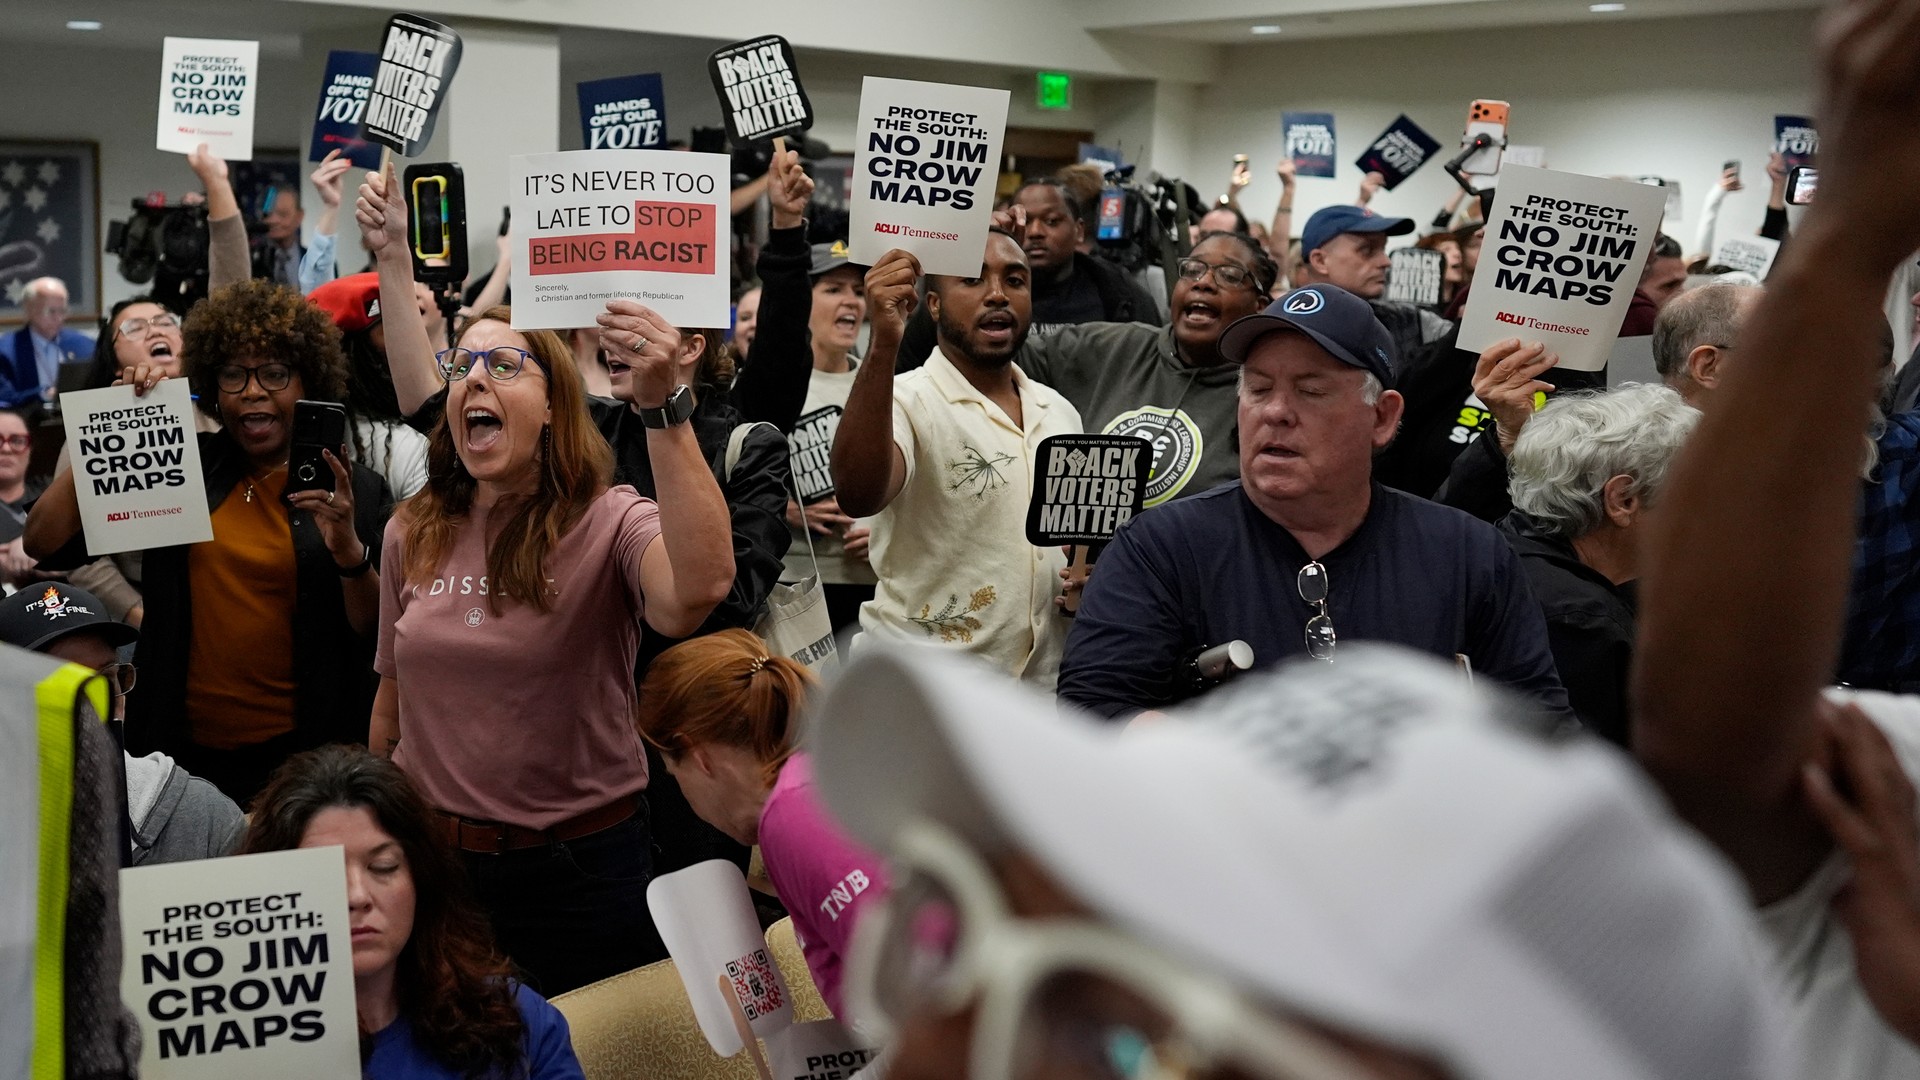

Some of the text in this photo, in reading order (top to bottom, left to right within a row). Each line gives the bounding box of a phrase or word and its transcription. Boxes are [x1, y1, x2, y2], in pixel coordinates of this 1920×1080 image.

[174, 62, 246, 72] THE SOUTH:
[182, 55, 239, 64] PROTECT
[171, 72, 246, 86] NO JIM
[327, 85, 352, 97] OFF
[334, 73, 373, 88] HAND
[373, 60, 441, 110] VOTERS
[724, 70, 798, 111] VOTERS
[172, 86, 244, 101] CROW
[594, 98, 651, 115] HANDS
[174, 102, 240, 116] MAPS
[319, 97, 367, 124] VOT
[365, 92, 428, 142] MATTER
[590, 109, 657, 127] OFF OUR
[732, 94, 807, 137] MATTER
[888, 106, 978, 126] PROTECT
[590, 120, 662, 150] VOTE
[874, 117, 988, 140] THE SOUTH:
[868, 132, 988, 164] NO JIM
[572, 170, 656, 192] NEVER
[662, 172, 714, 194] TOO
[868, 156, 982, 187] CROW
[870, 180, 974, 211] MAPS
[1526, 194, 1628, 220] PROTECT
[537, 205, 702, 230] LATE TO STOP
[1510, 205, 1638, 236] THE SOUTH:
[874, 222, 958, 241] ACLU Tennessee
[1500, 220, 1637, 260] NO JIM
[532, 240, 708, 265] BEING RACIST
[1496, 245, 1626, 282] CROW
[535, 284, 569, 292] Sincerely,
[541, 294, 573, 303] Christian
[574, 293, 588, 301] and
[613, 291, 641, 300] lifelong
[642, 291, 684, 300] Republican
[1494, 268, 1614, 306] MAPS
[1495, 312, 1590, 336] ACLU Tennessee
[79, 414, 180, 435] THE SOUTH:
[88, 404, 166, 422] PROTECT
[79, 426, 184, 456] NO JIM
[86, 447, 184, 476] CROW
[790, 442, 830, 476] VOTE
[92, 468, 186, 496] MAPS
[1046, 477, 1136, 506] VOTERS
[107, 506, 182, 522] ACLU Tennessee
[25, 600, 44, 612] IT'S
[163, 892, 302, 924] PROTECT
[820, 869, 870, 922] TNB
[142, 912, 324, 946] THE SOUTH:
[142, 933, 330, 986] NO JIM
[148, 971, 326, 1022] CROW
[158, 1010, 326, 1060] MAPS
[806, 1049, 881, 1071] PROT
